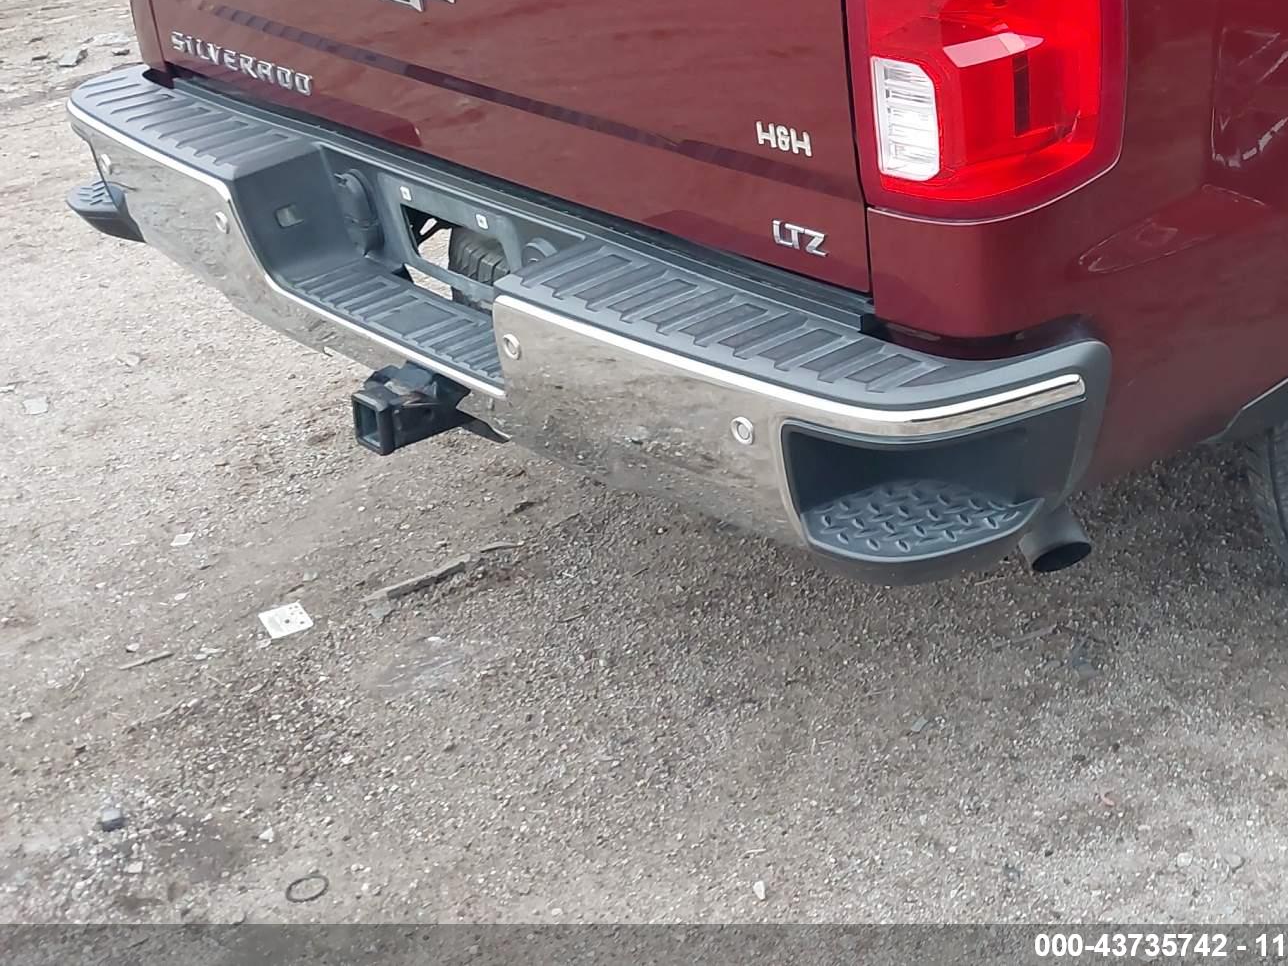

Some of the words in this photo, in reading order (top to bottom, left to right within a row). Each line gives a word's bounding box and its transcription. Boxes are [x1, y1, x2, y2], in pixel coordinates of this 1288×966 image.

[171, 31, 313, 96] SILVERADO
[756, 121, 813, 157] H&H
[772, 220, 829, 257] LTZ
